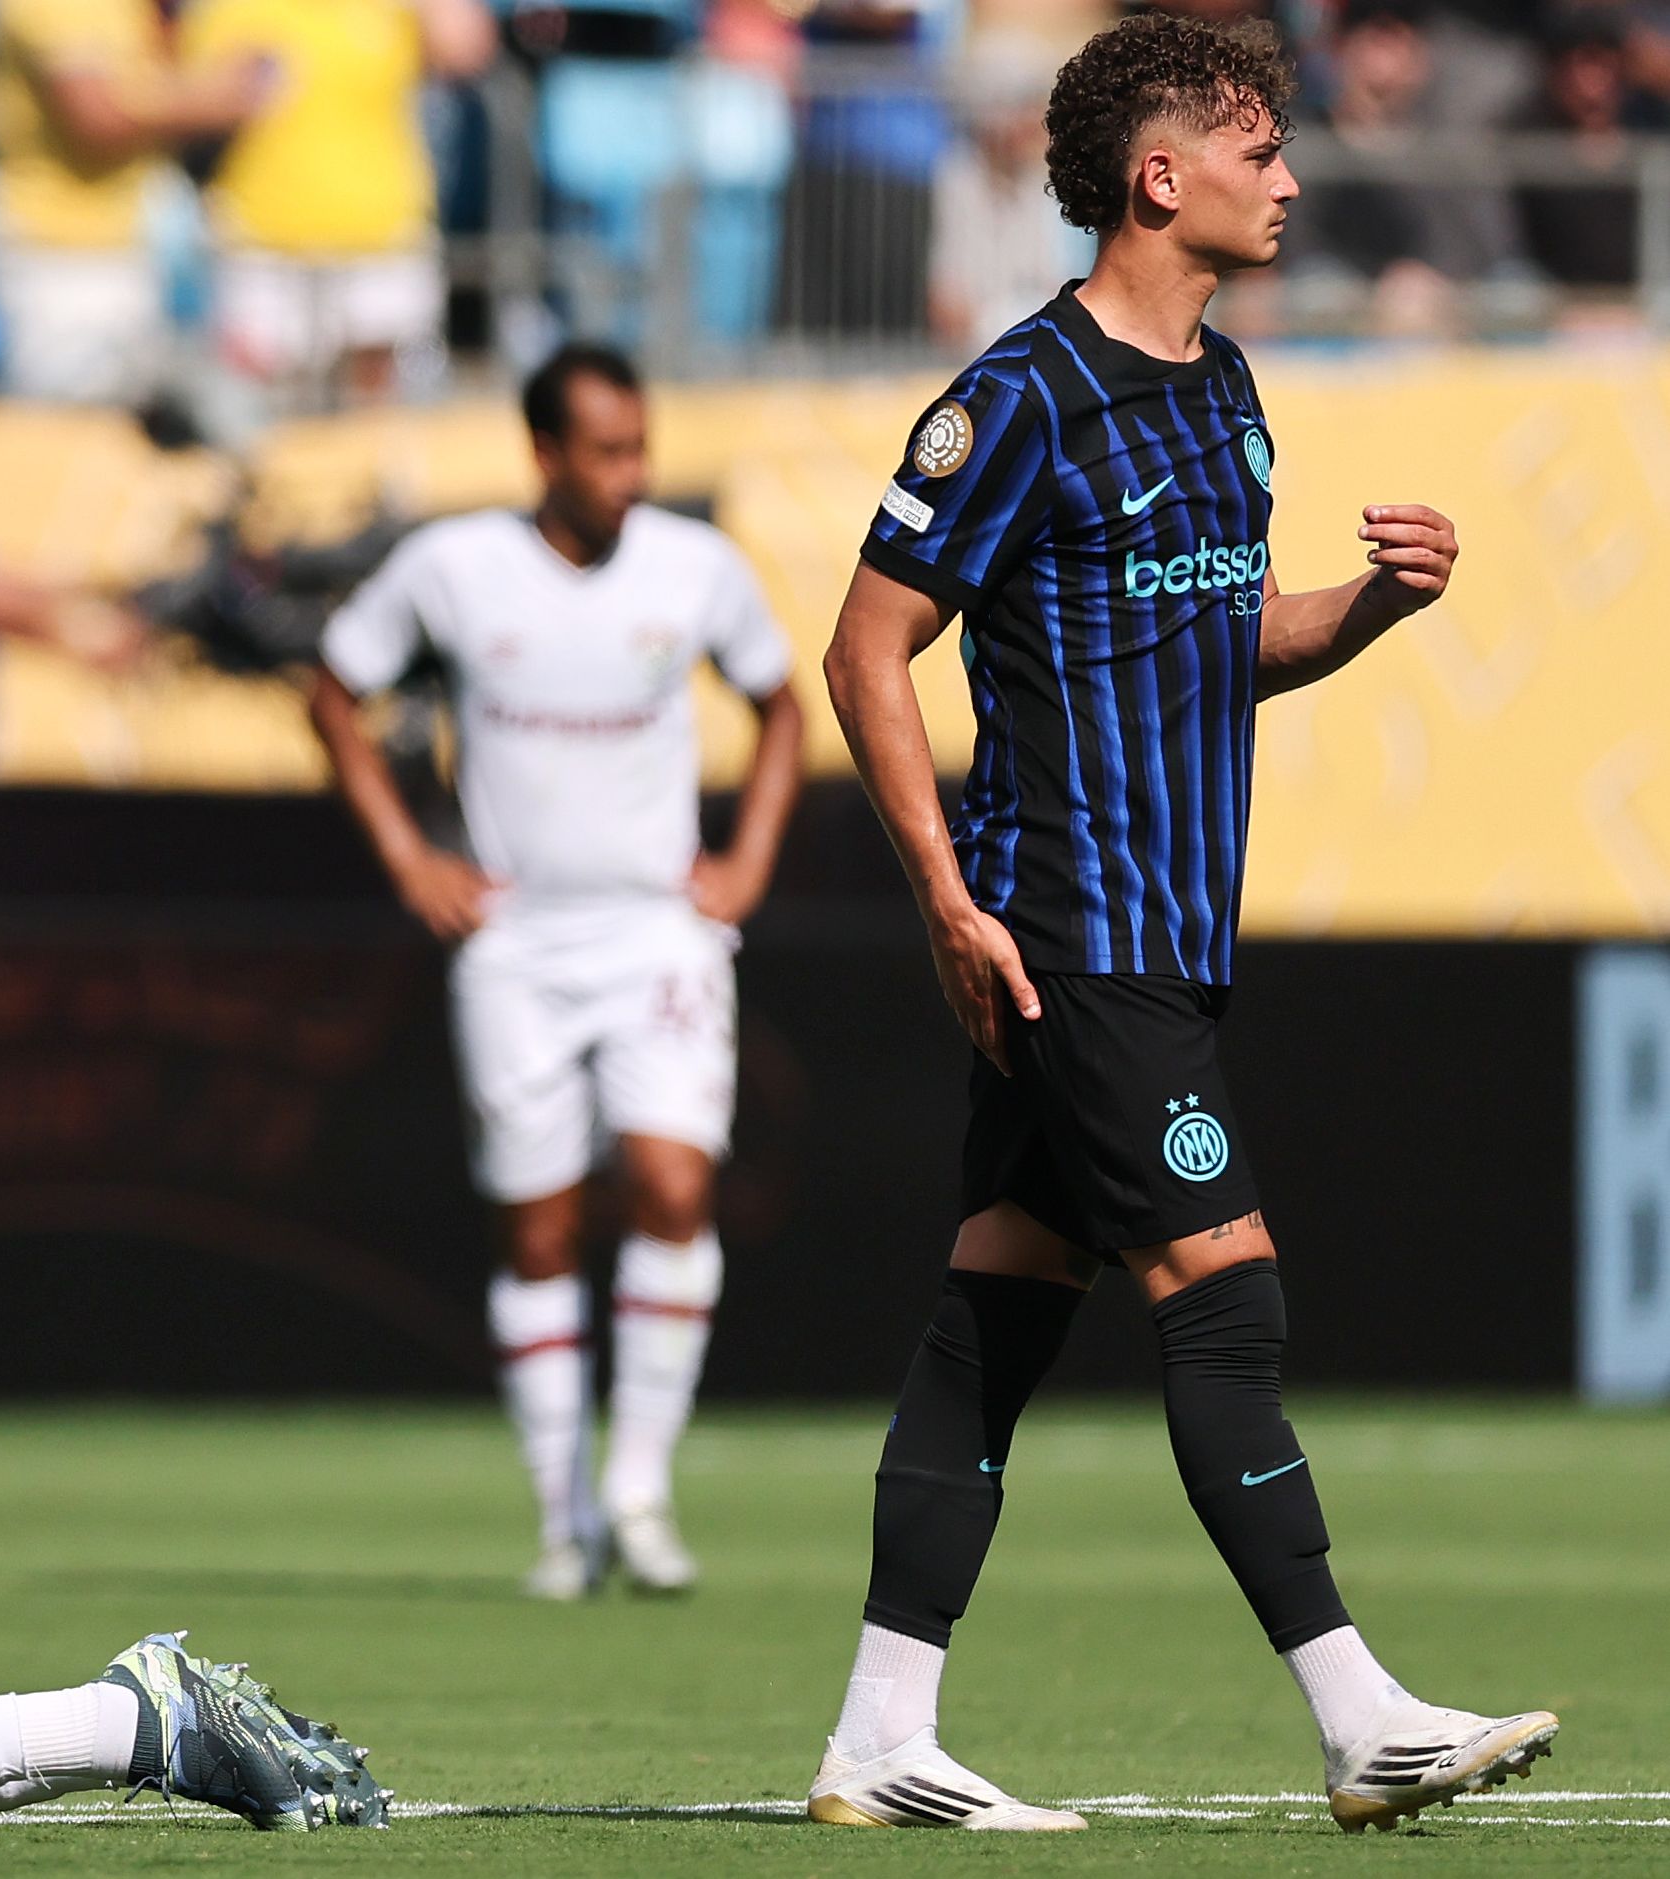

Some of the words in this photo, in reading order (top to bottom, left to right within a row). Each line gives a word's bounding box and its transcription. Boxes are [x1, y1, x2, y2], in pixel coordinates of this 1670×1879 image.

[953, 414, 966, 434] CUP
[918, 451, 937, 472] FIFA
[941, 450, 960, 467] USA
[1125, 536, 1267, 598] betsso
